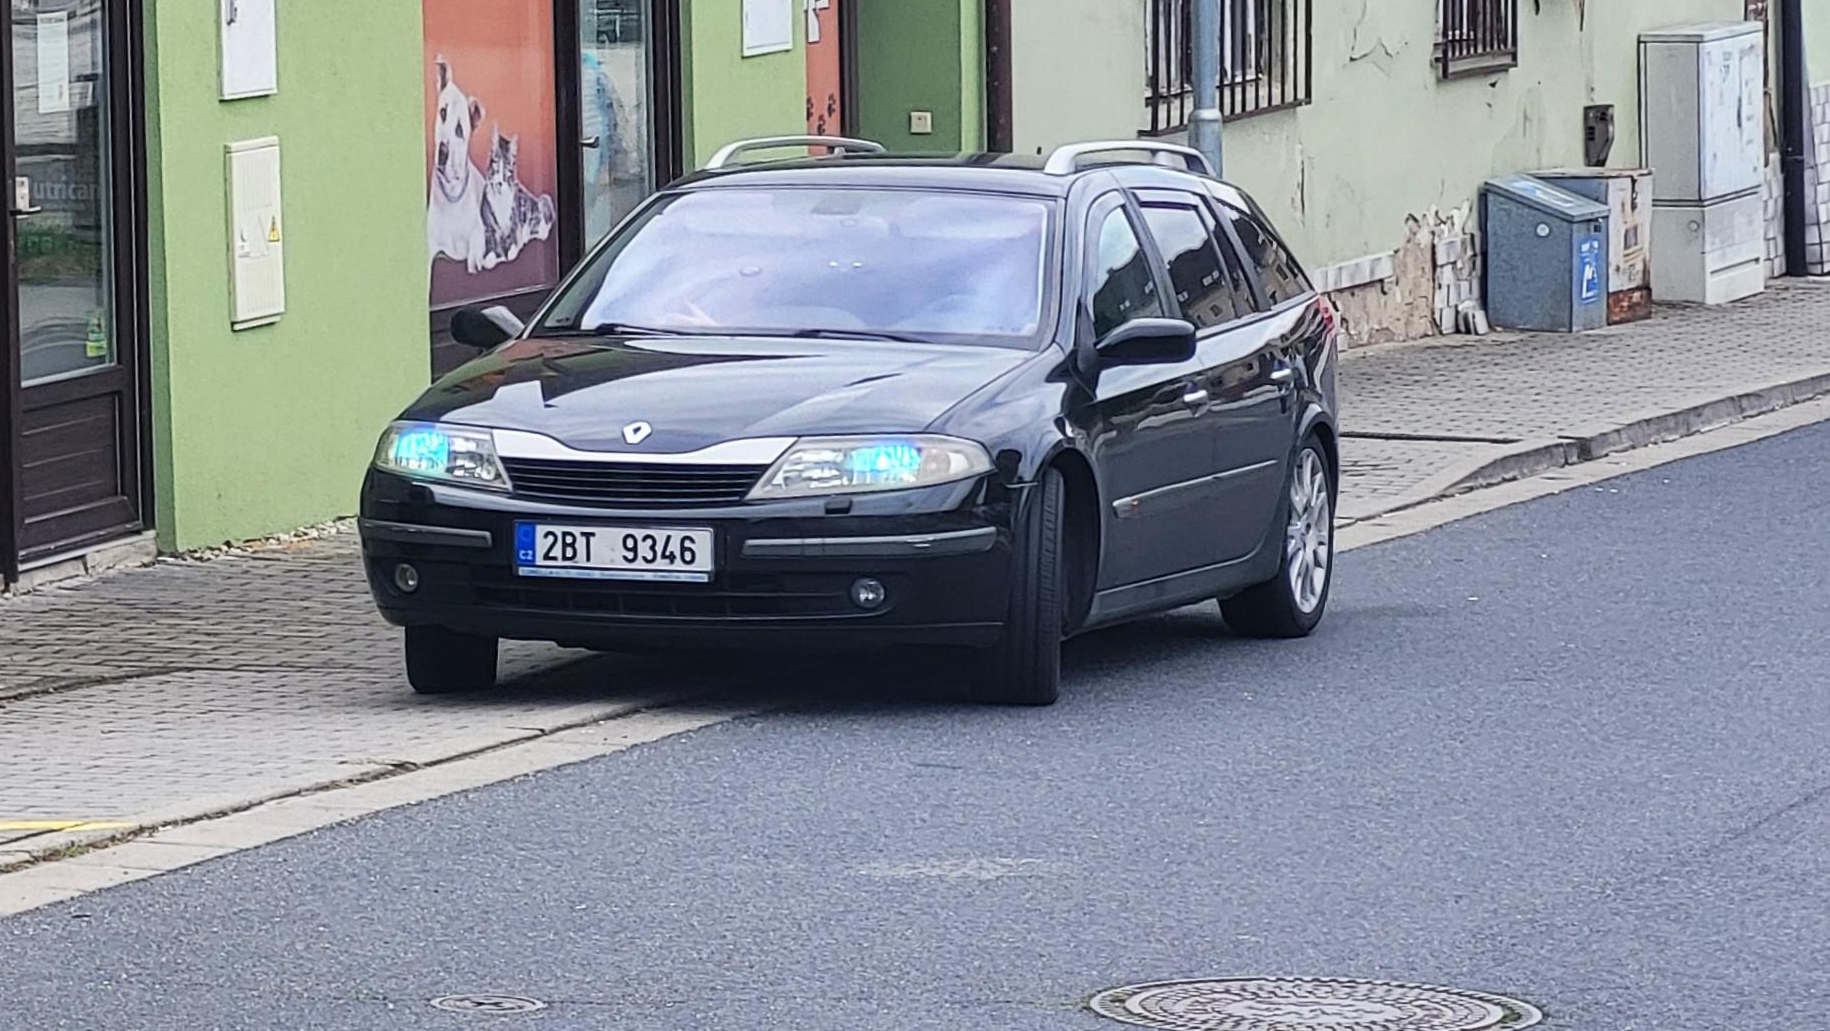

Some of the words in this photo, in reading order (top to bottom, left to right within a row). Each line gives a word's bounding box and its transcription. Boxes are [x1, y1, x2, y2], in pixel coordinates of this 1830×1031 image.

[519, 550, 533, 560] CZ
[542, 530, 596, 563] 2BT
[621, 533, 697, 566] 9346
